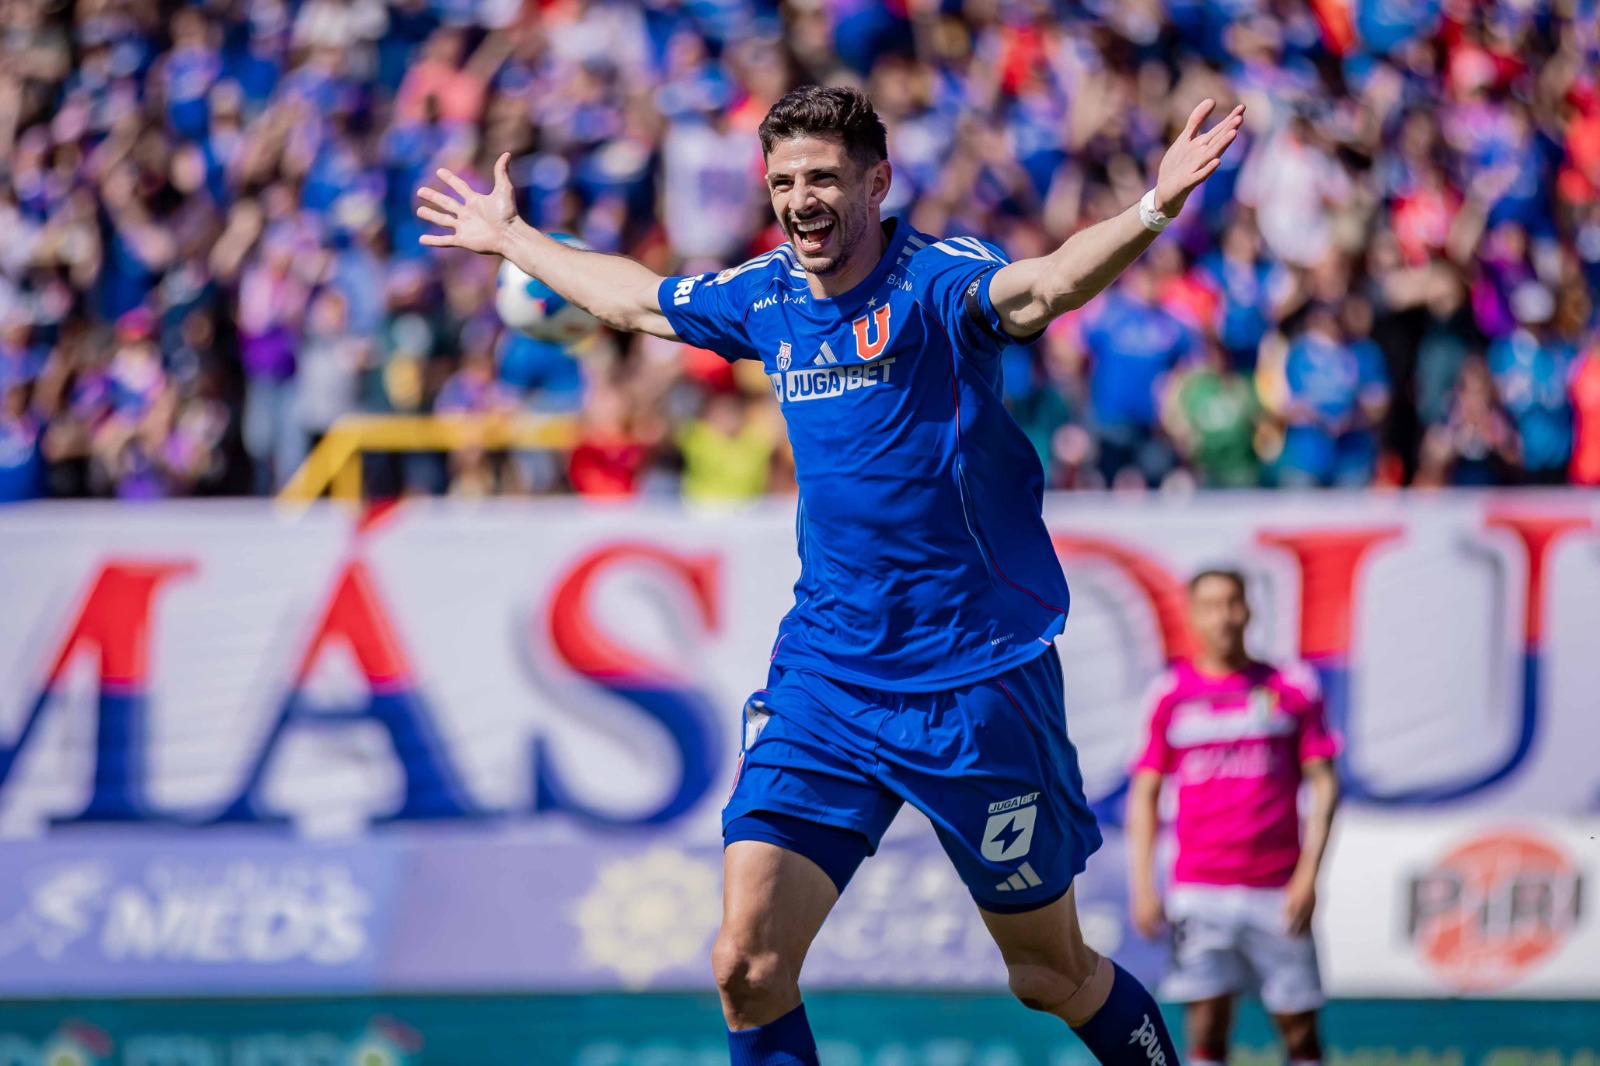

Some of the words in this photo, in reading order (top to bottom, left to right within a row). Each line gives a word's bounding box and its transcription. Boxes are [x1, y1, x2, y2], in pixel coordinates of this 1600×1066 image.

[852, 302, 891, 361] U
[787, 357, 896, 400] JUGABET
[988, 792, 1041, 814] JUGABET
[1128, 1013, 1167, 1066] anet
